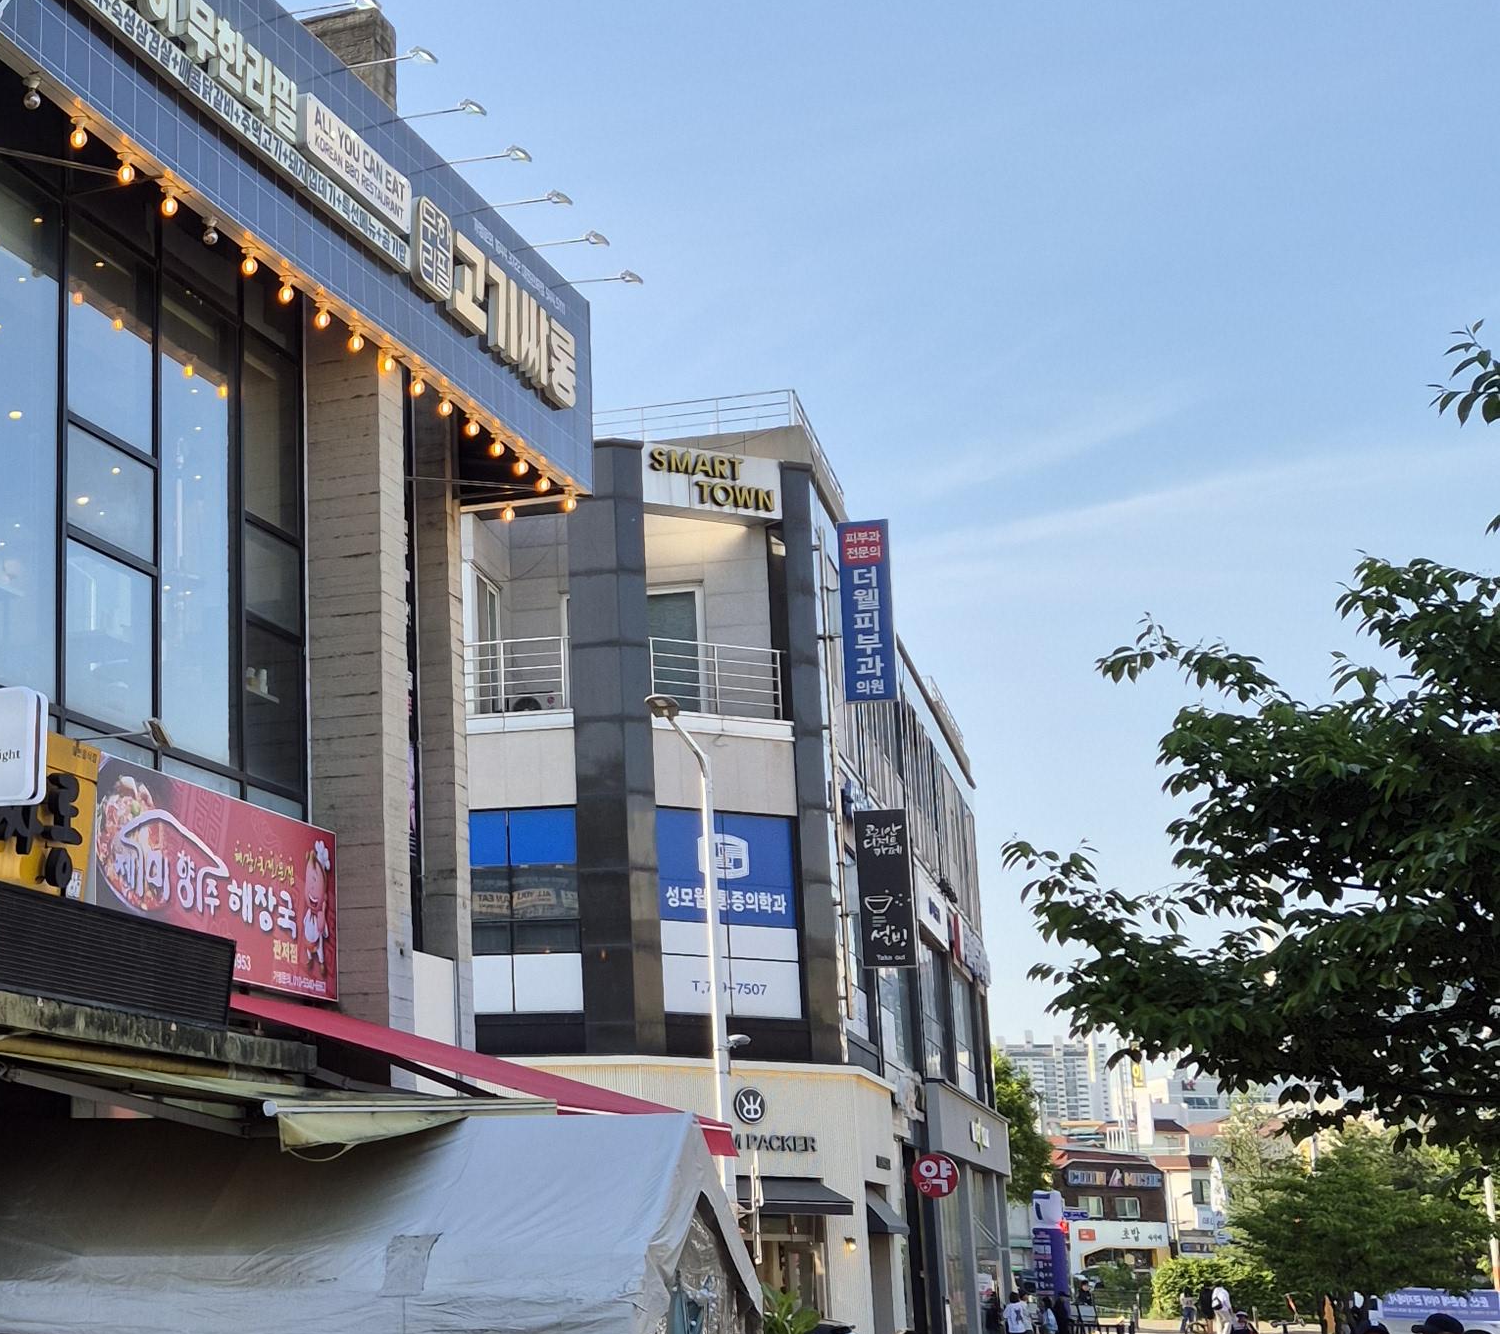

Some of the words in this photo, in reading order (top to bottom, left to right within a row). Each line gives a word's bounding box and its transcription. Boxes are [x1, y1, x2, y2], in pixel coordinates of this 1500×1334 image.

[314, 106, 333, 134] ALL
[337, 129, 361, 163] YOU
[362, 148, 383, 181] CAN
[386, 170, 406, 201] EAT
[314, 134, 344, 169] KOREAN
[345, 159, 360, 186] BBQ
[361, 174, 405, 221] RESTAURANT
[649, 447, 744, 480] SMART
[695, 480, 776, 513] TOWN
[845, 530, 881, 545] 피부과
[845, 545, 881, 560] 전문의
[745, 1134, 818, 1153] PACKER
[1121, 1226, 1141, 1243] 초밥
